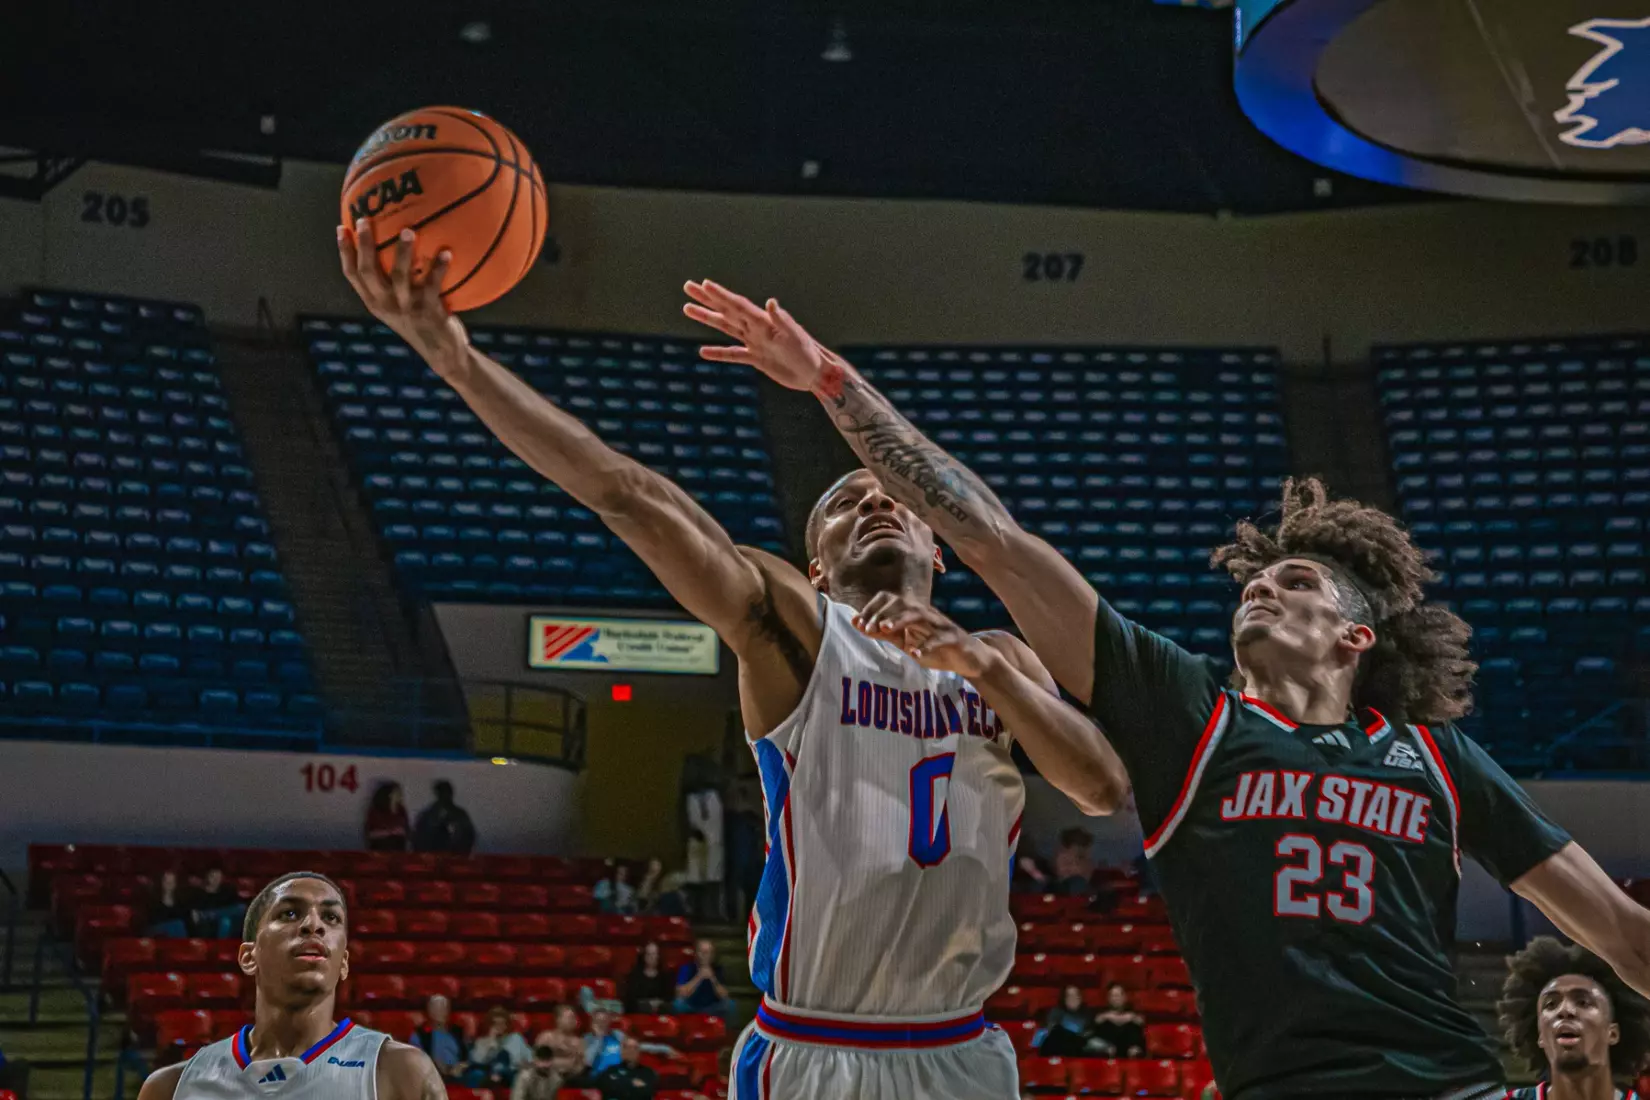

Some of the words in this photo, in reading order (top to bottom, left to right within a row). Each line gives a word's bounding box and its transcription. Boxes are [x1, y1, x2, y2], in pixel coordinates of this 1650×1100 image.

[81, 190, 150, 228] 205
[350, 167, 424, 219] NCAA
[1022, 251, 1084, 282] 207
[840, 676, 963, 739] LOUISI
[958, 687, 1004, 743] EC
[300, 762, 359, 794] 104
[1221, 769, 1315, 821] JAX
[1316, 774, 1432, 844] STATE
[908, 751, 956, 869] 0
[1273, 832, 1375, 925] 23
